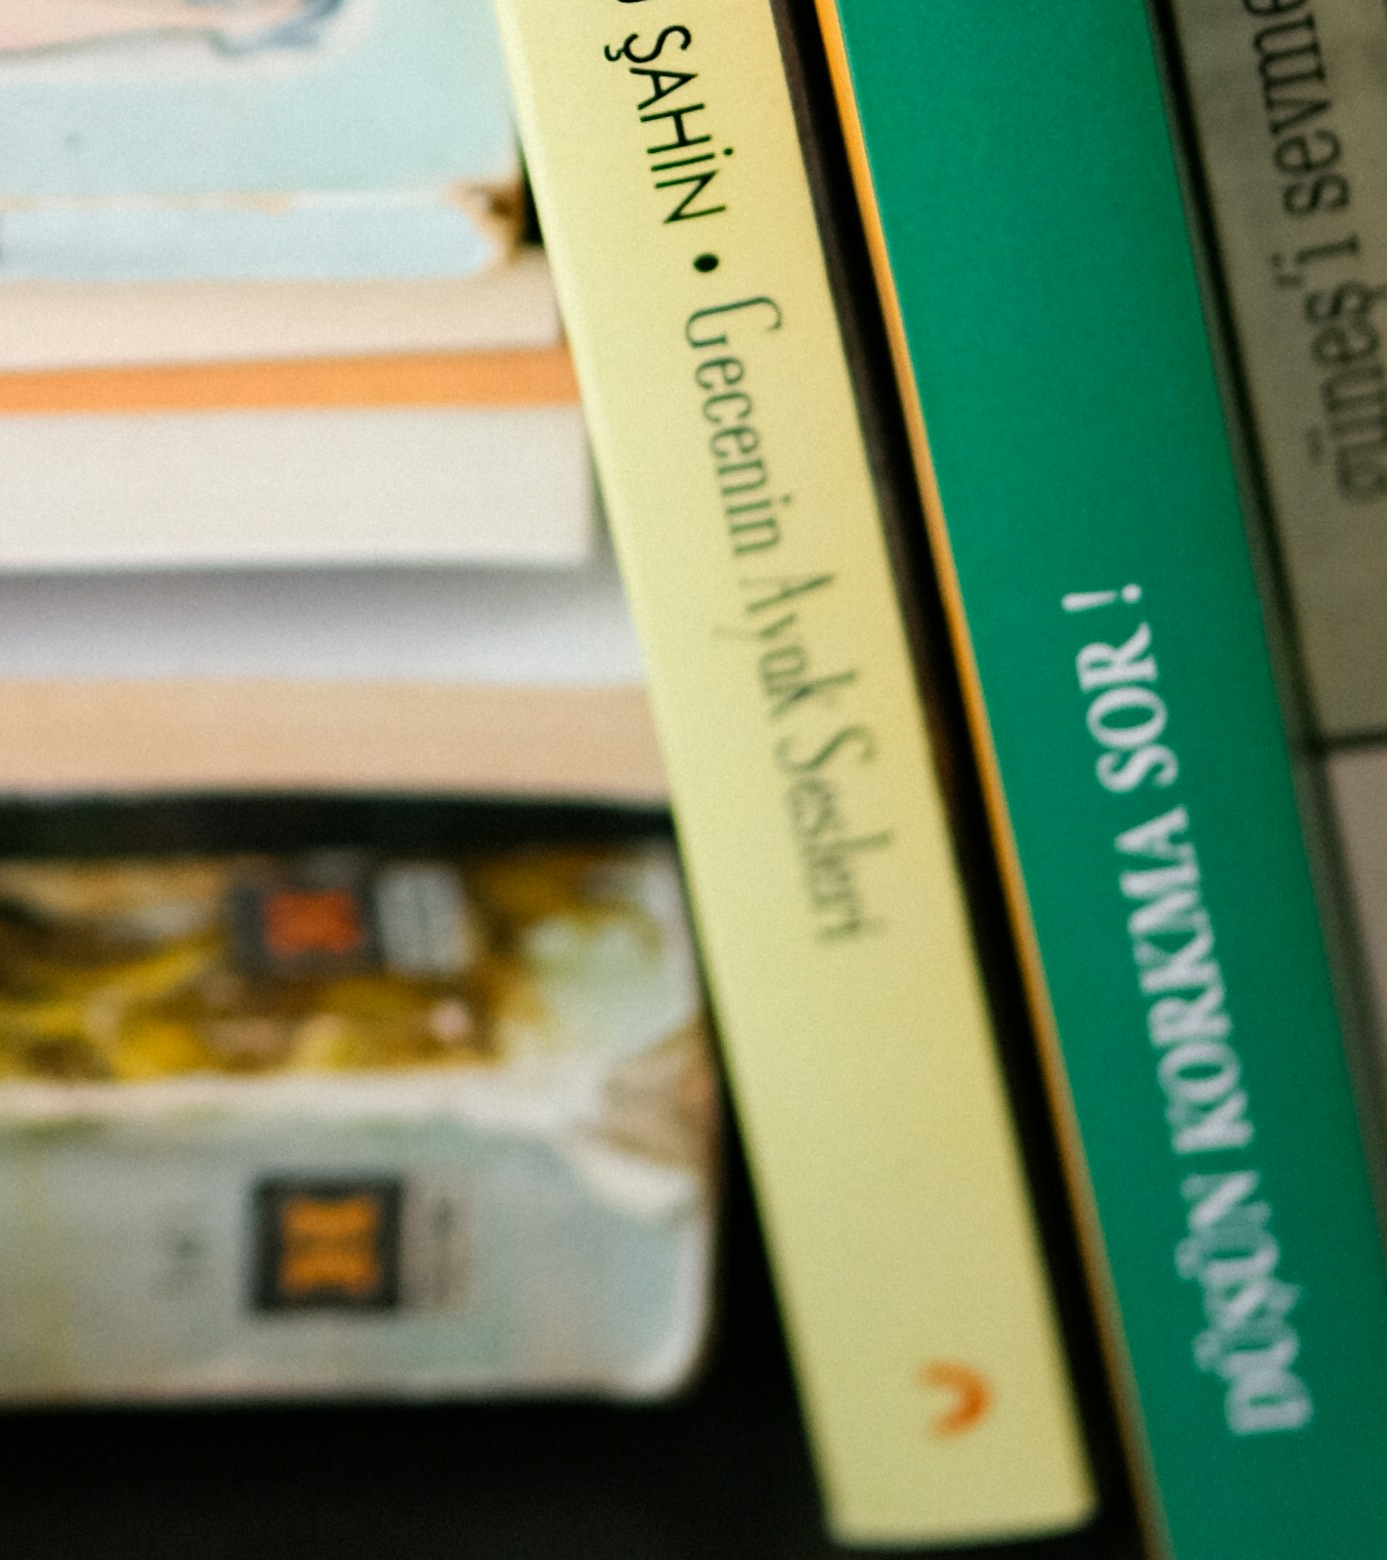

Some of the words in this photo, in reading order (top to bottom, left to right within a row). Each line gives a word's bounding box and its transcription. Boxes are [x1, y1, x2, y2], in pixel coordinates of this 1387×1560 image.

[603, 24, 736, 226] ŞAHİN
[683, 293, 794, 558] Gecenin
[1075, 620, 1181, 796] SOR
[1111, 803, 1257, 1156] KORKMA
